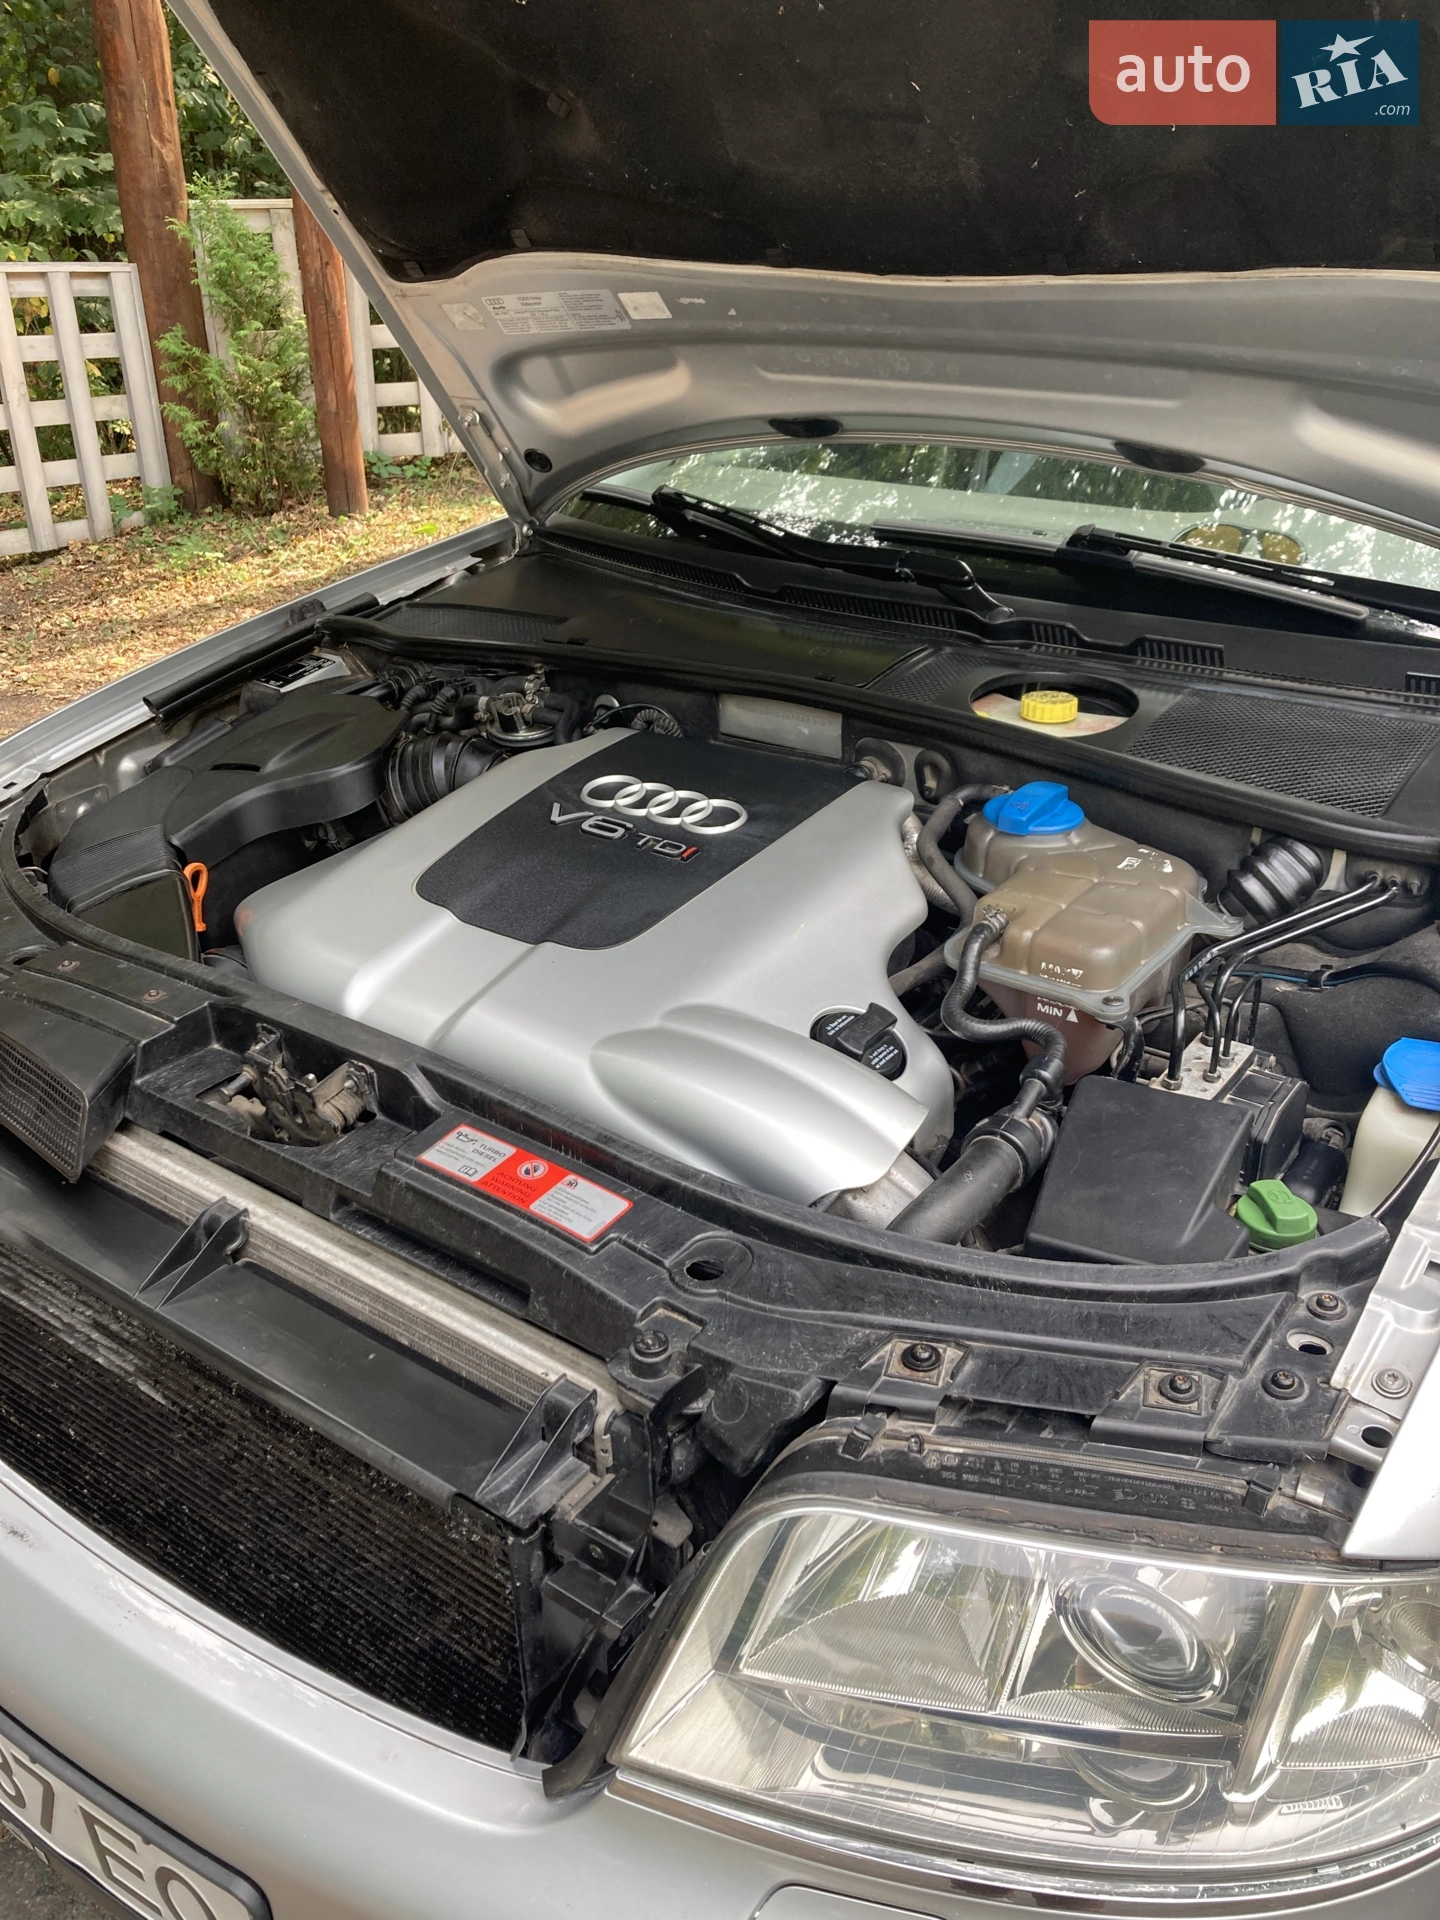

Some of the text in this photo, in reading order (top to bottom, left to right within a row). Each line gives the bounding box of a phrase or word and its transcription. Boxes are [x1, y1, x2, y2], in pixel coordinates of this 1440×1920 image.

[550, 802, 699, 862] V6 TDI
[1037, 1002, 1063, 1017] MIN
[470, 1147, 499, 1162] DIESEL
[478, 1143, 507, 1158] TURBO
[480, 1179, 527, 1204] ATTENTION
[489, 1175, 532, 1197] WARNING
[496, 1170, 538, 1192] ACHTUNG
